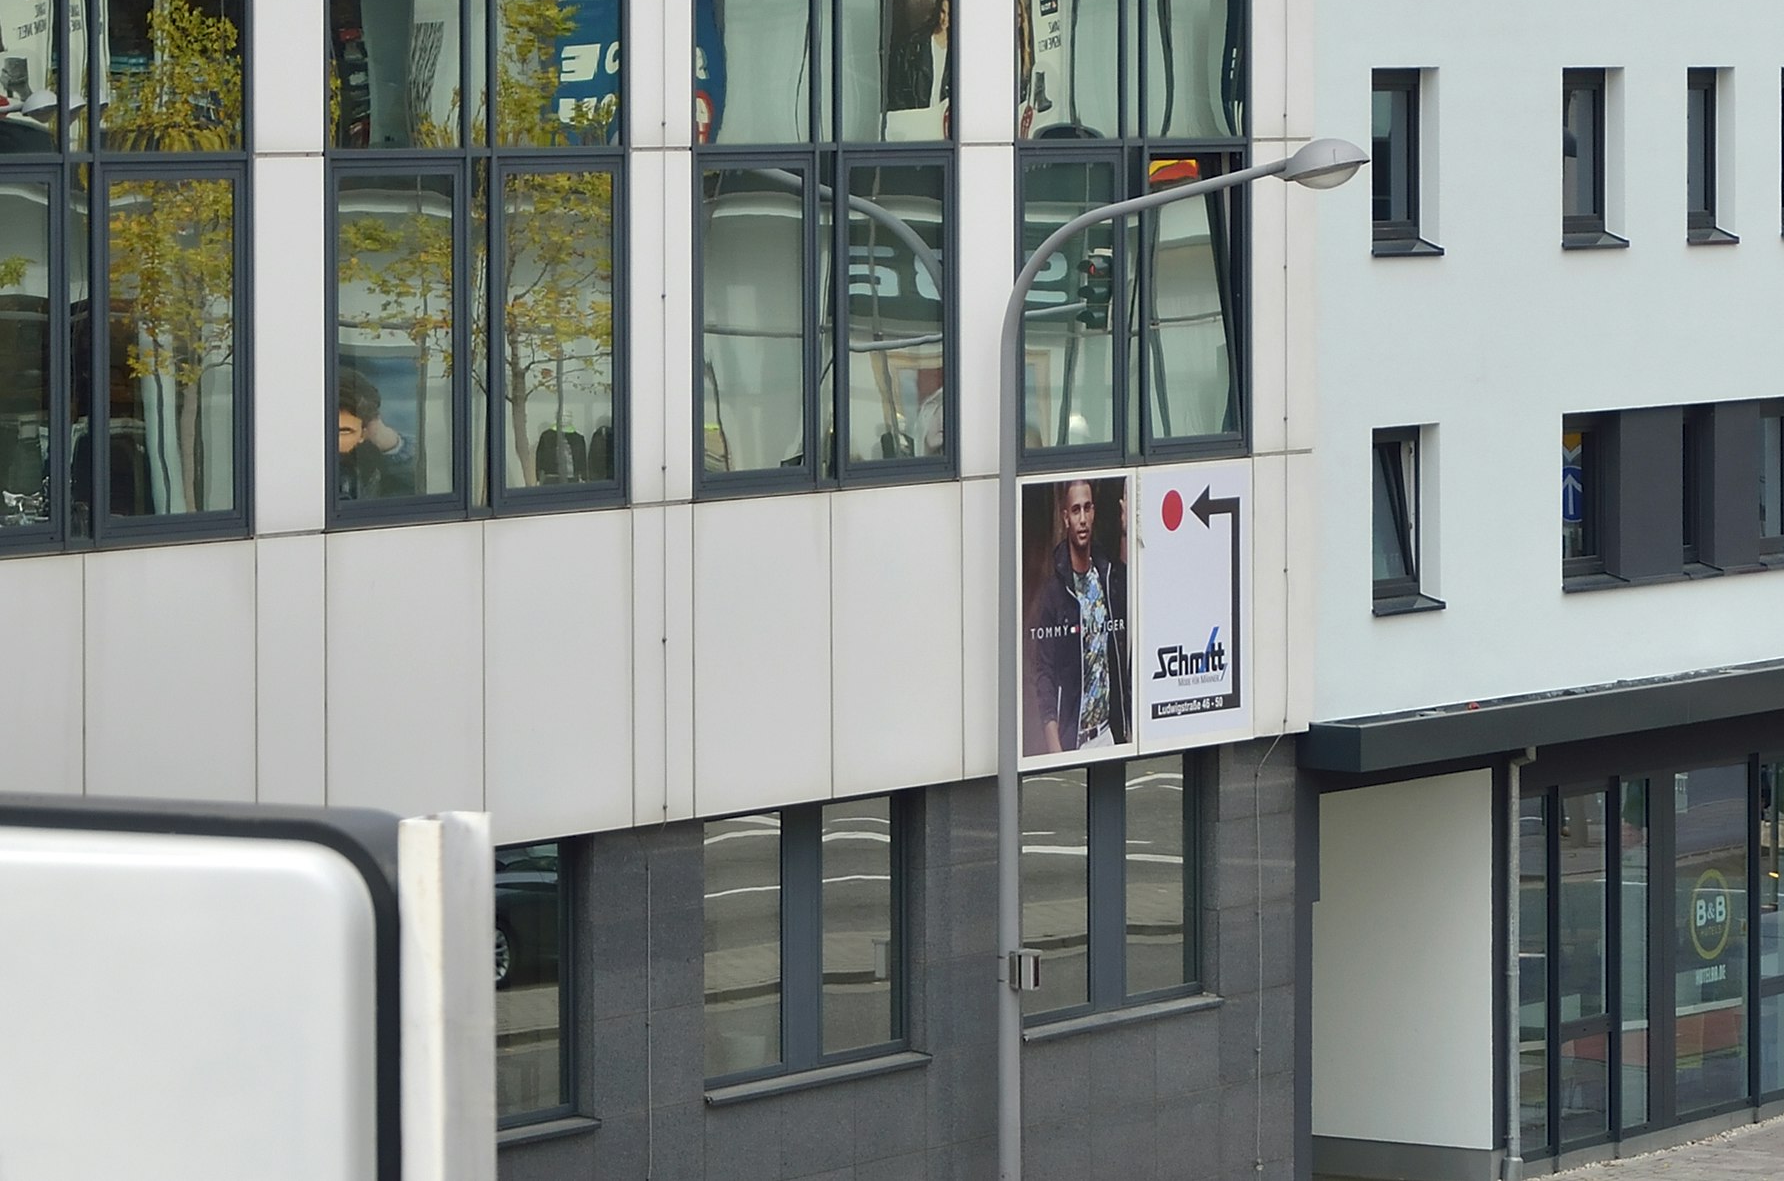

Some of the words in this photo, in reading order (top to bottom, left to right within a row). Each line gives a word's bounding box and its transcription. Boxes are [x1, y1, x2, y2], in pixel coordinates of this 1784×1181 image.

[1030, 625, 1069, 640] TOMMY
[1081, 618, 1125, 633] HILFIGER
[1152, 627, 1227, 680] Schmitt
[1158, 699, 1201, 716] Ludwigstraße
[1696, 895, 1726, 926] B&B
